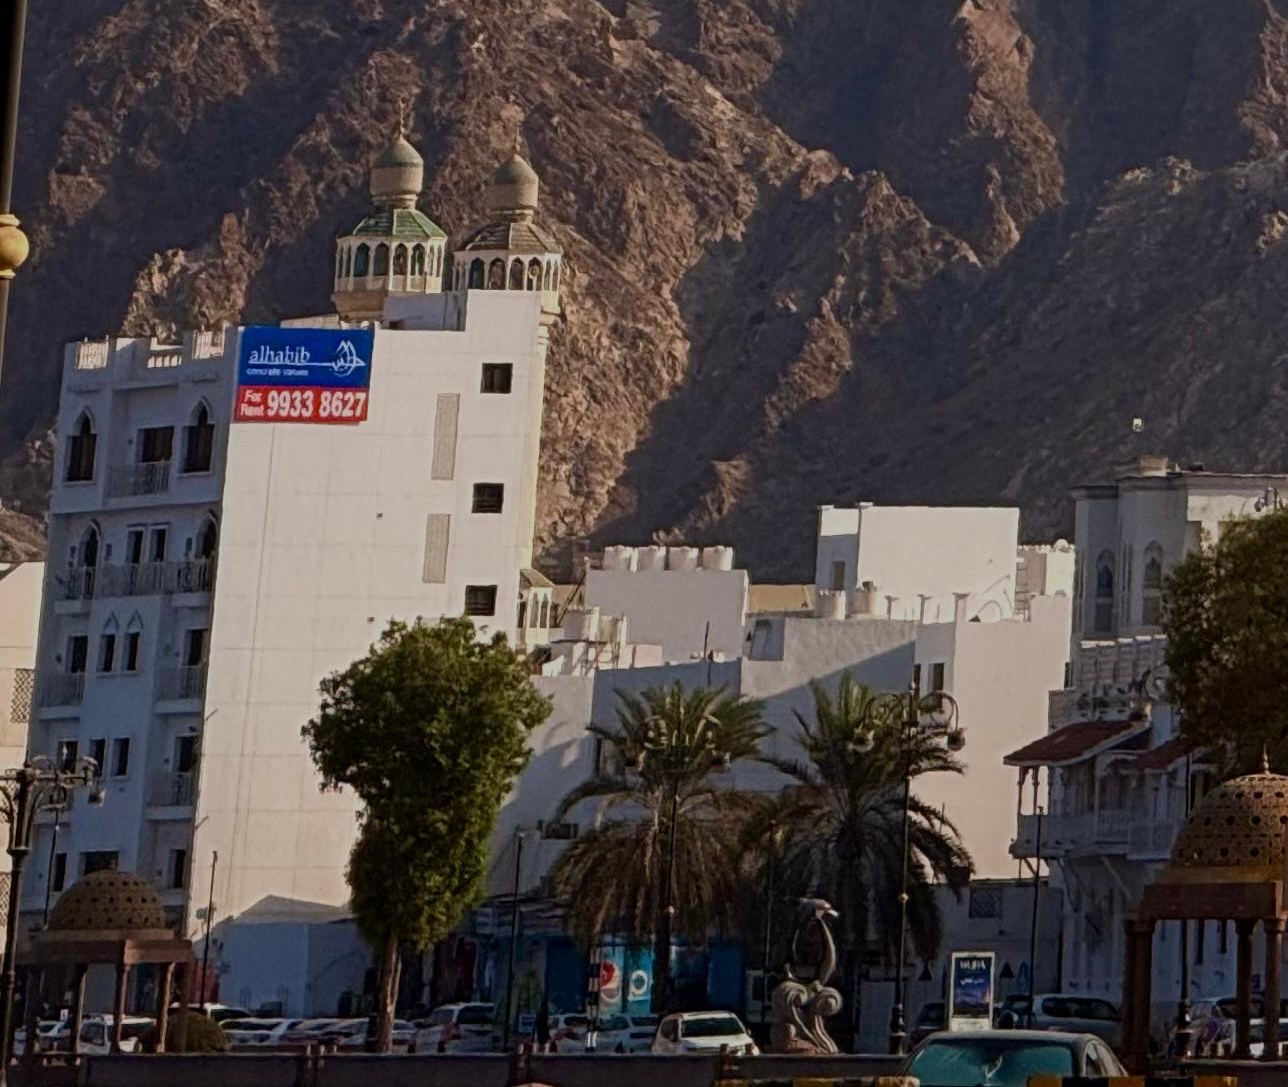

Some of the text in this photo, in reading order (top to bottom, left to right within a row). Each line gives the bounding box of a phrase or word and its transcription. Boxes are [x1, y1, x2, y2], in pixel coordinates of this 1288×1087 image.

[249, 345, 311, 363] alhabib
[244, 389, 263, 403] For
[267, 390, 367, 418] 9933 8627
[240, 403, 265, 417] Rent
